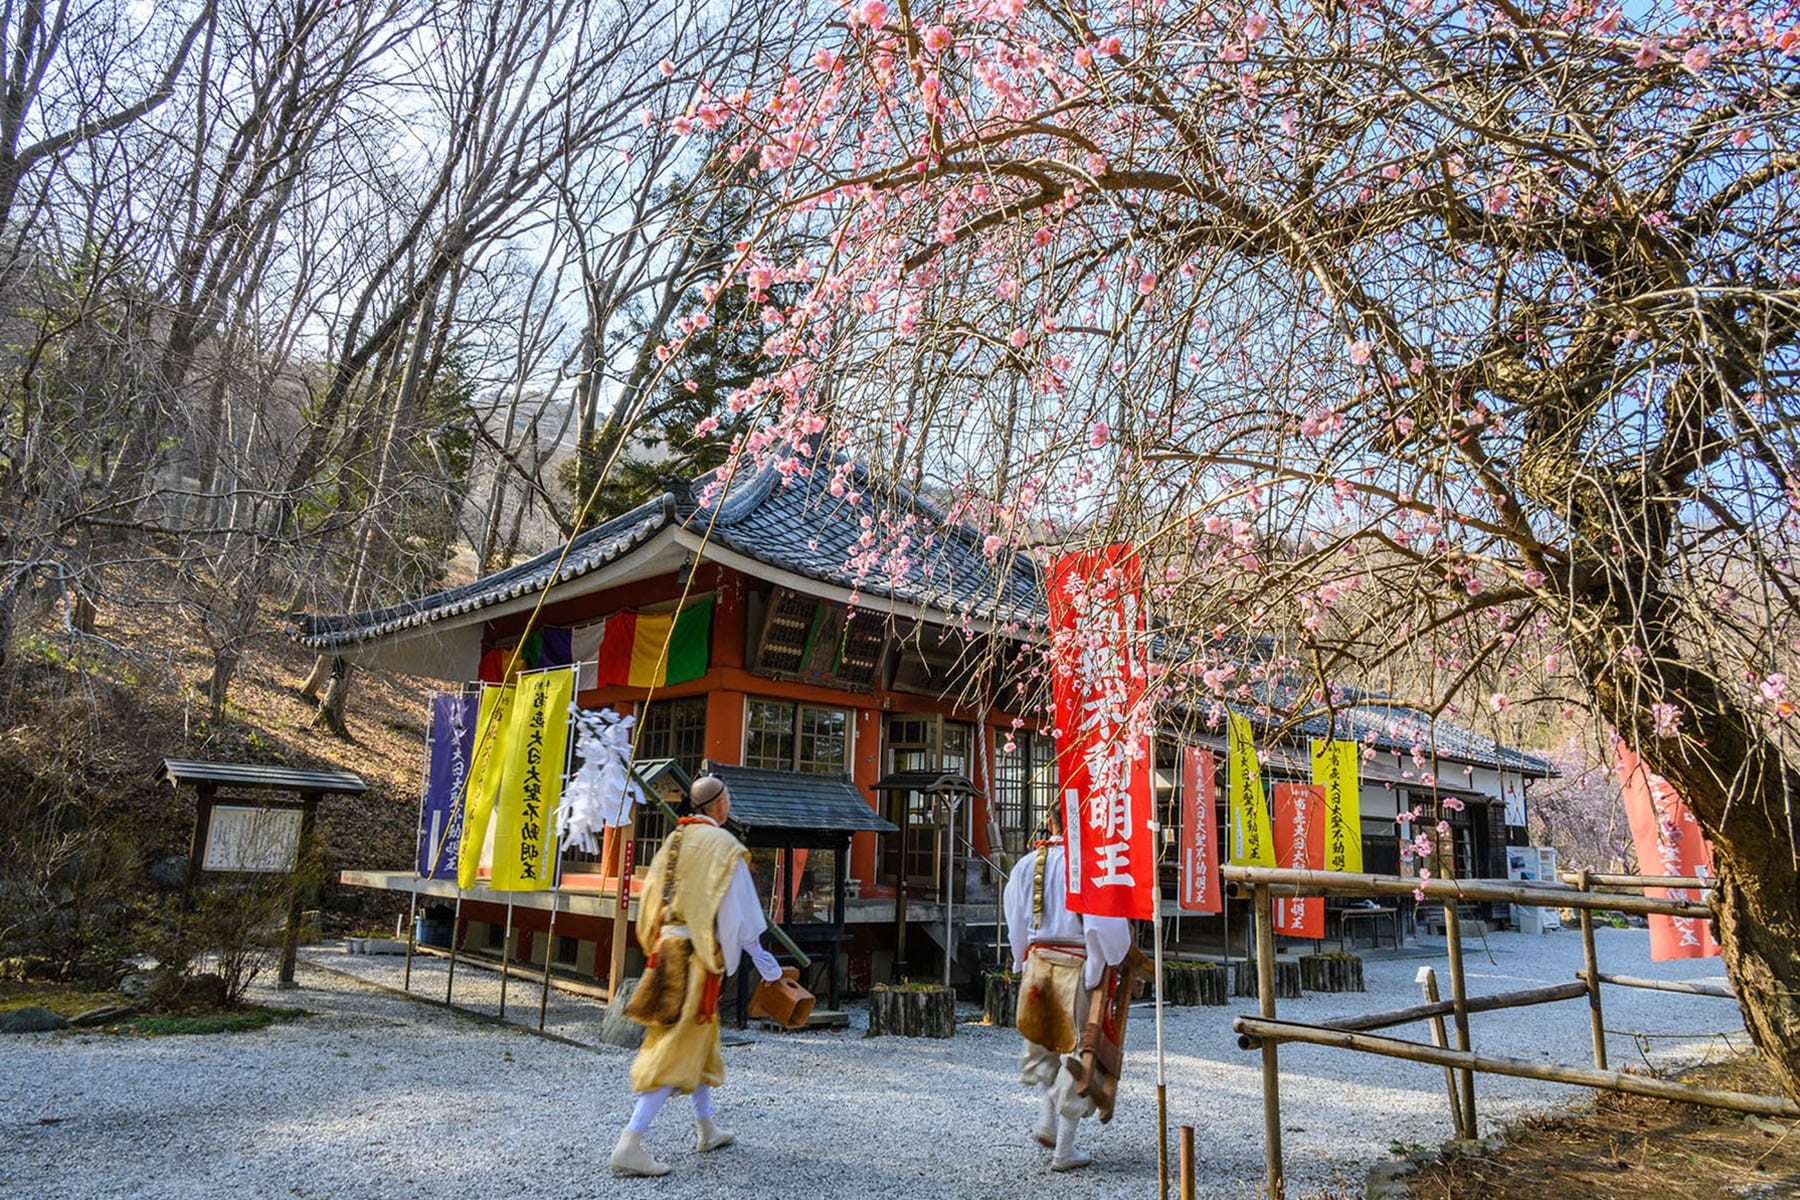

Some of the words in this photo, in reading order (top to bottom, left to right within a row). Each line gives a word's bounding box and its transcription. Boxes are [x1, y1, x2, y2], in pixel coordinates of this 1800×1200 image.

[444, 706, 465, 872] 大日大聖不動明王
[1329, 755, 1345, 871] 南無大日大聖不動明
